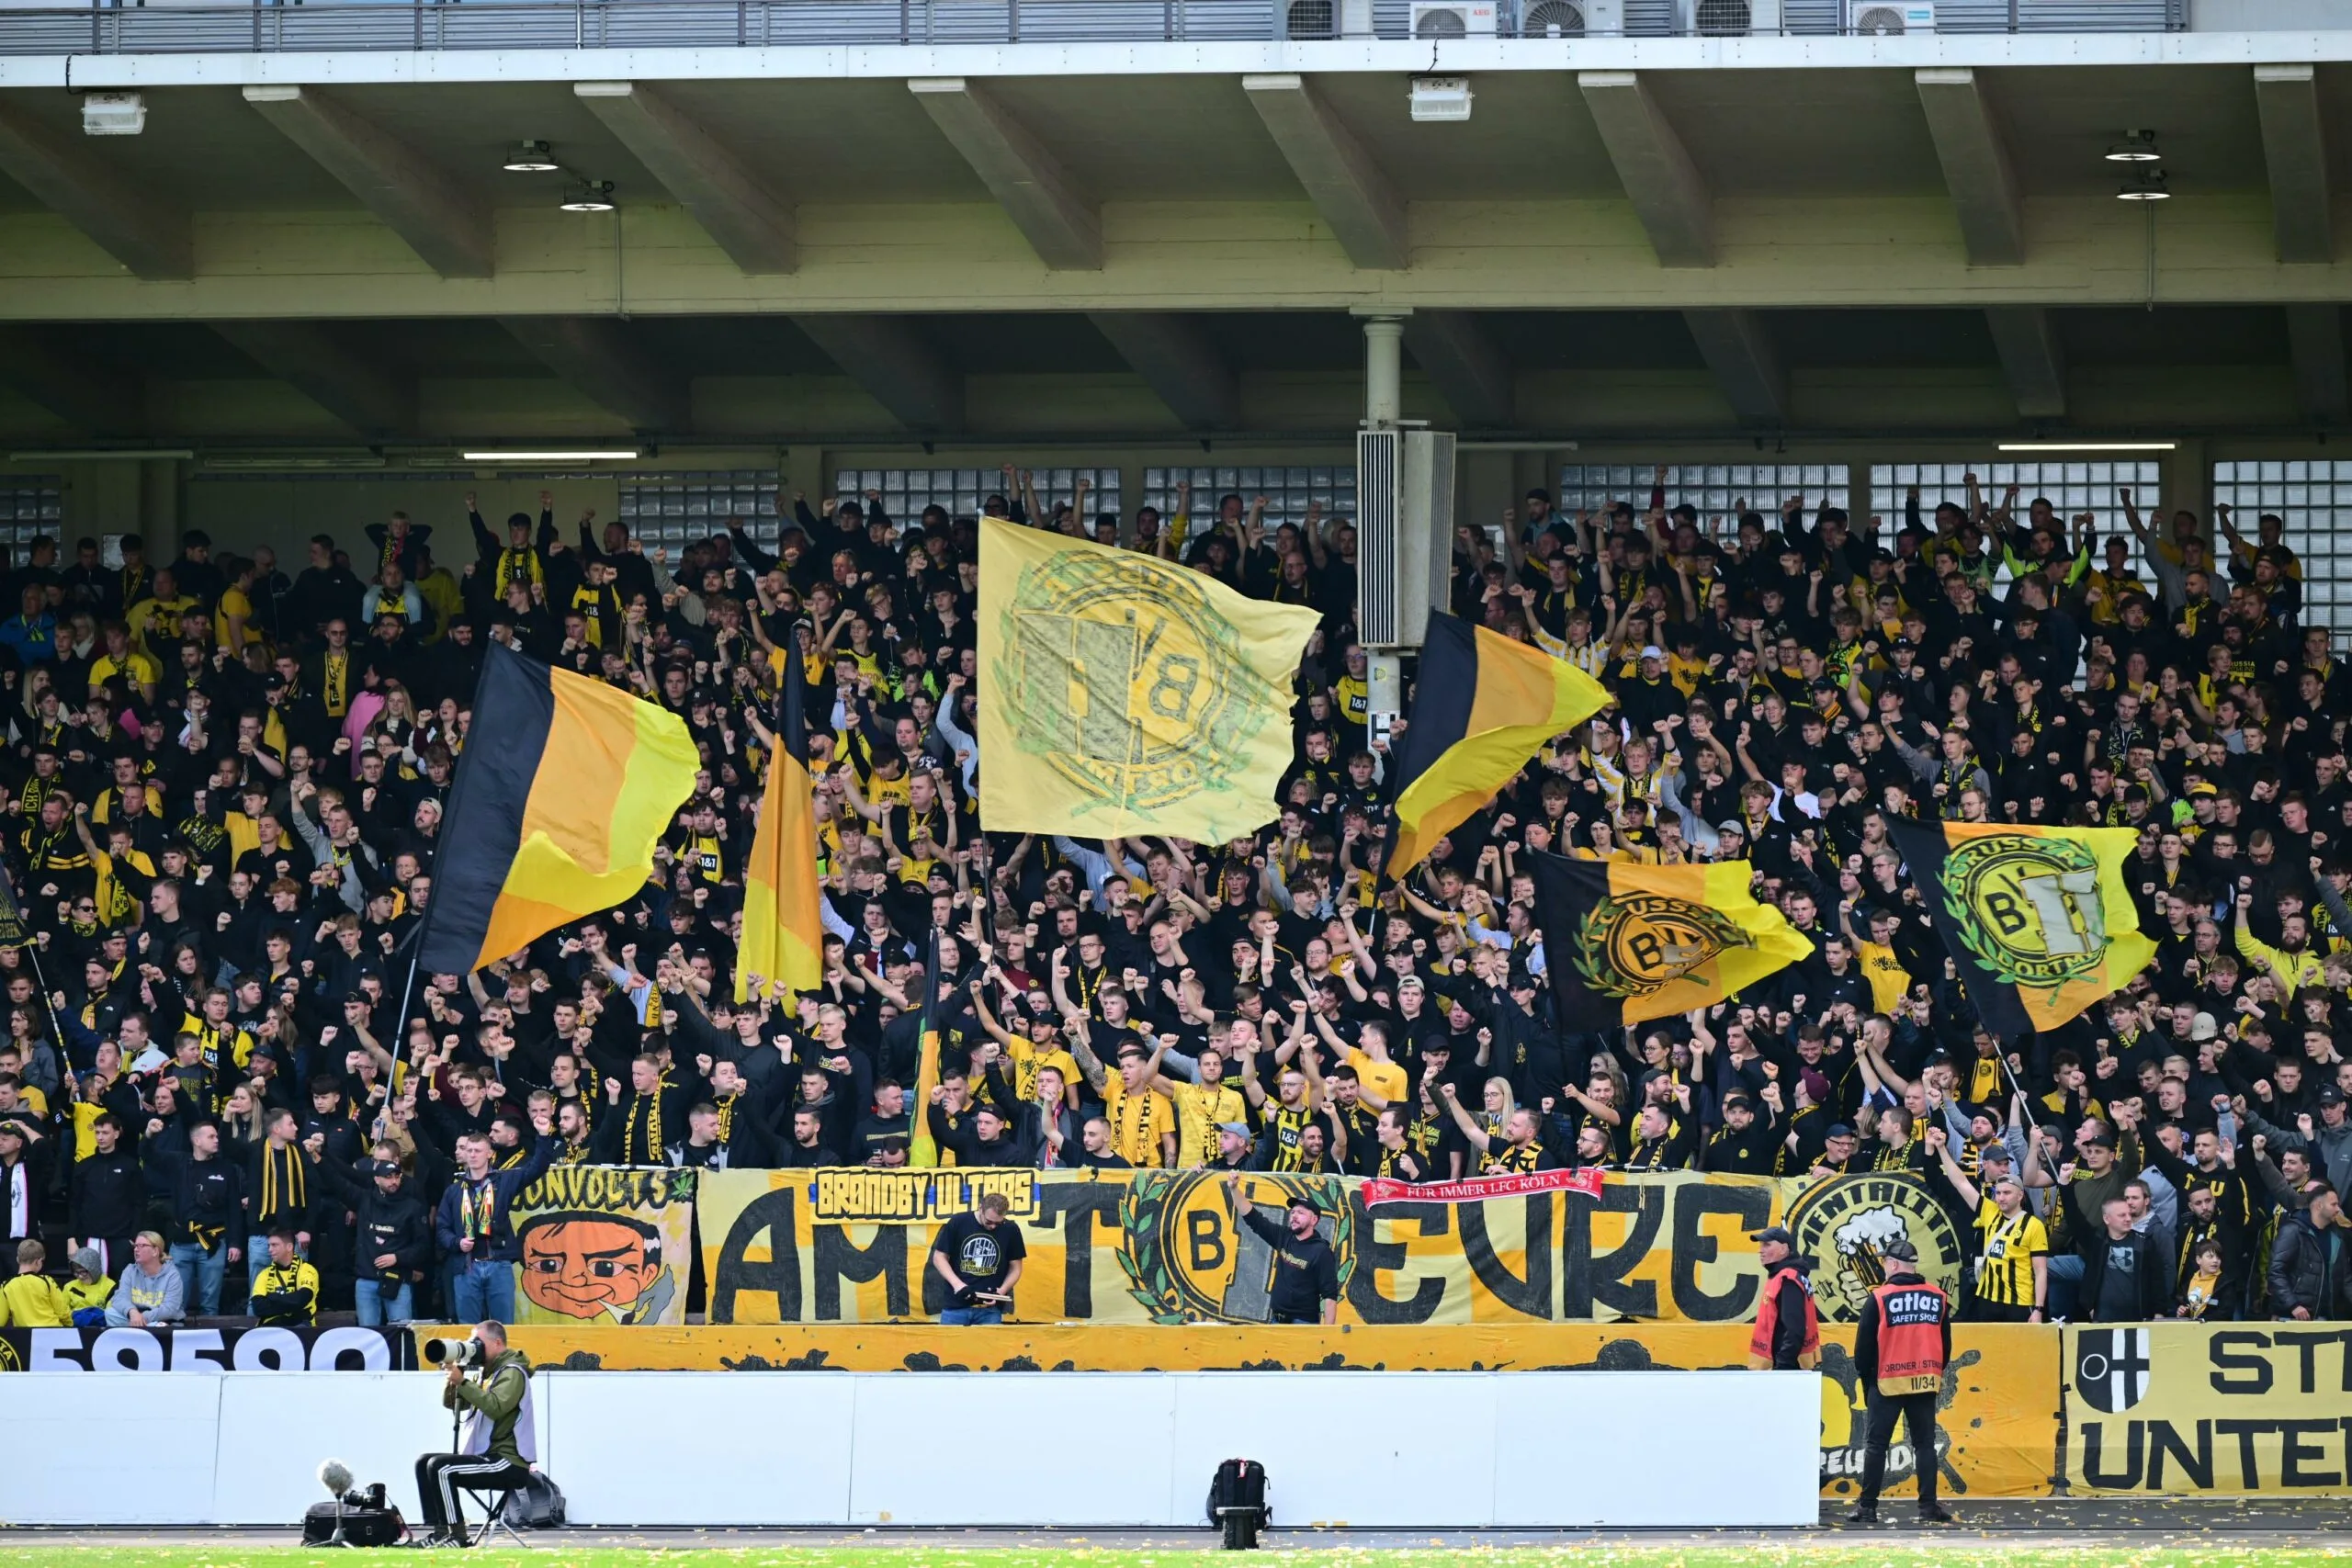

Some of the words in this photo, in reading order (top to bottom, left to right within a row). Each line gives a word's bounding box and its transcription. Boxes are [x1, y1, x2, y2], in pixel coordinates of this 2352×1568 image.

[1351, 697, 1366, 709] 1&1
[701, 856, 717, 868] 1&1
[204, 1050, 218, 1062] 1&1
[1282, 1131, 1297, 1145] 1&1
[1407, 1183, 1436, 1199] FÜR
[1440, 1185, 1485, 1198] IMMER
[1490, 1180, 1516, 1193] 1.FC
[1521, 1174, 1560, 1190] KÖLN
[1889, 1292, 1940, 1313] atlas
[1892, 1314, 1917, 1324] SAFETY
[1919, 1314, 1939, 1323] SHOE
[1884, 1361, 1917, 1372] ORDNER
[1910, 1376, 1935, 1391] II/34
[2081, 1416, 2352, 1490] UNTE
